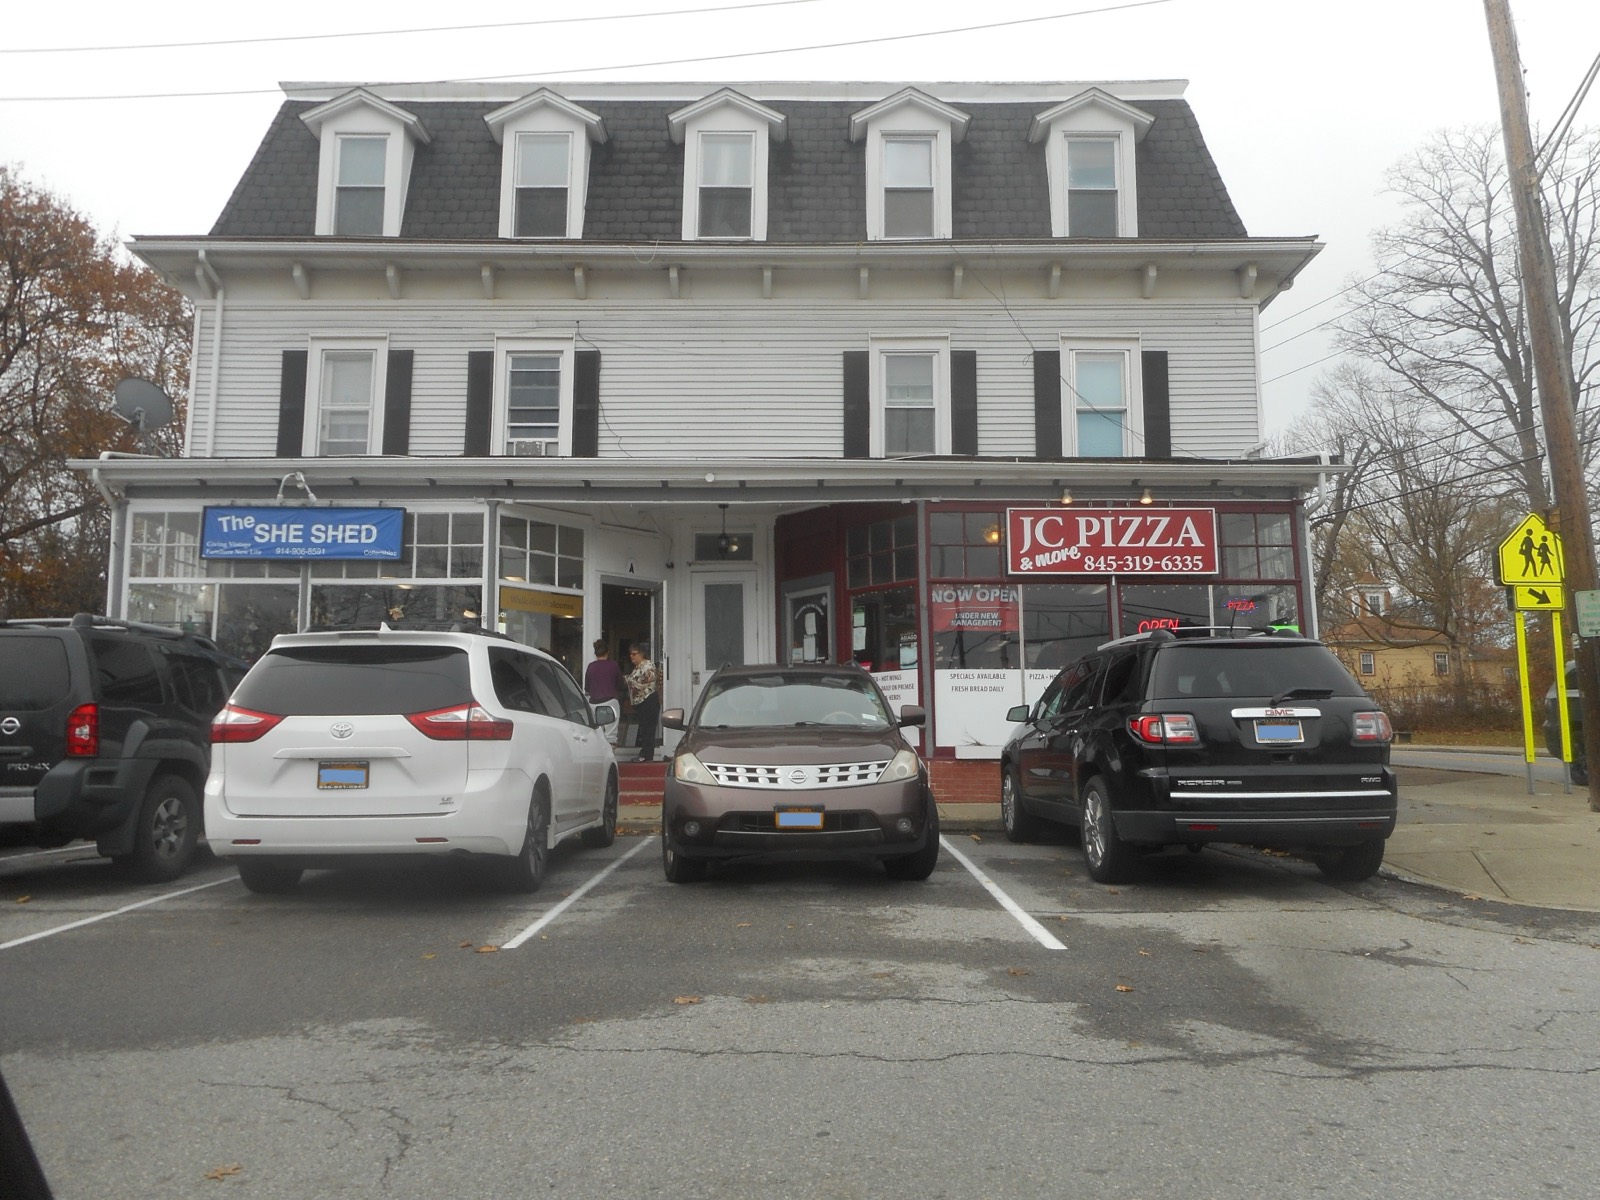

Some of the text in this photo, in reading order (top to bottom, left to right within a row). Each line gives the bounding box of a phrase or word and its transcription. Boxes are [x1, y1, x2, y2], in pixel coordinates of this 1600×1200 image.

[218, 515, 255, 532] The
[254, 524, 377, 543] SHE SHED
[1019, 516, 1205, 554] JC PIZZA
[1020, 545, 1081, 571] & more
[1084, 555, 1203, 571] 845-319-6335
[628, 562, 635, 574] A
[932, 588, 1019, 603] NOW OPEN
[1228, 601, 1255, 611] PIZZA
[7, 763, 50, 771] PRO-4X
